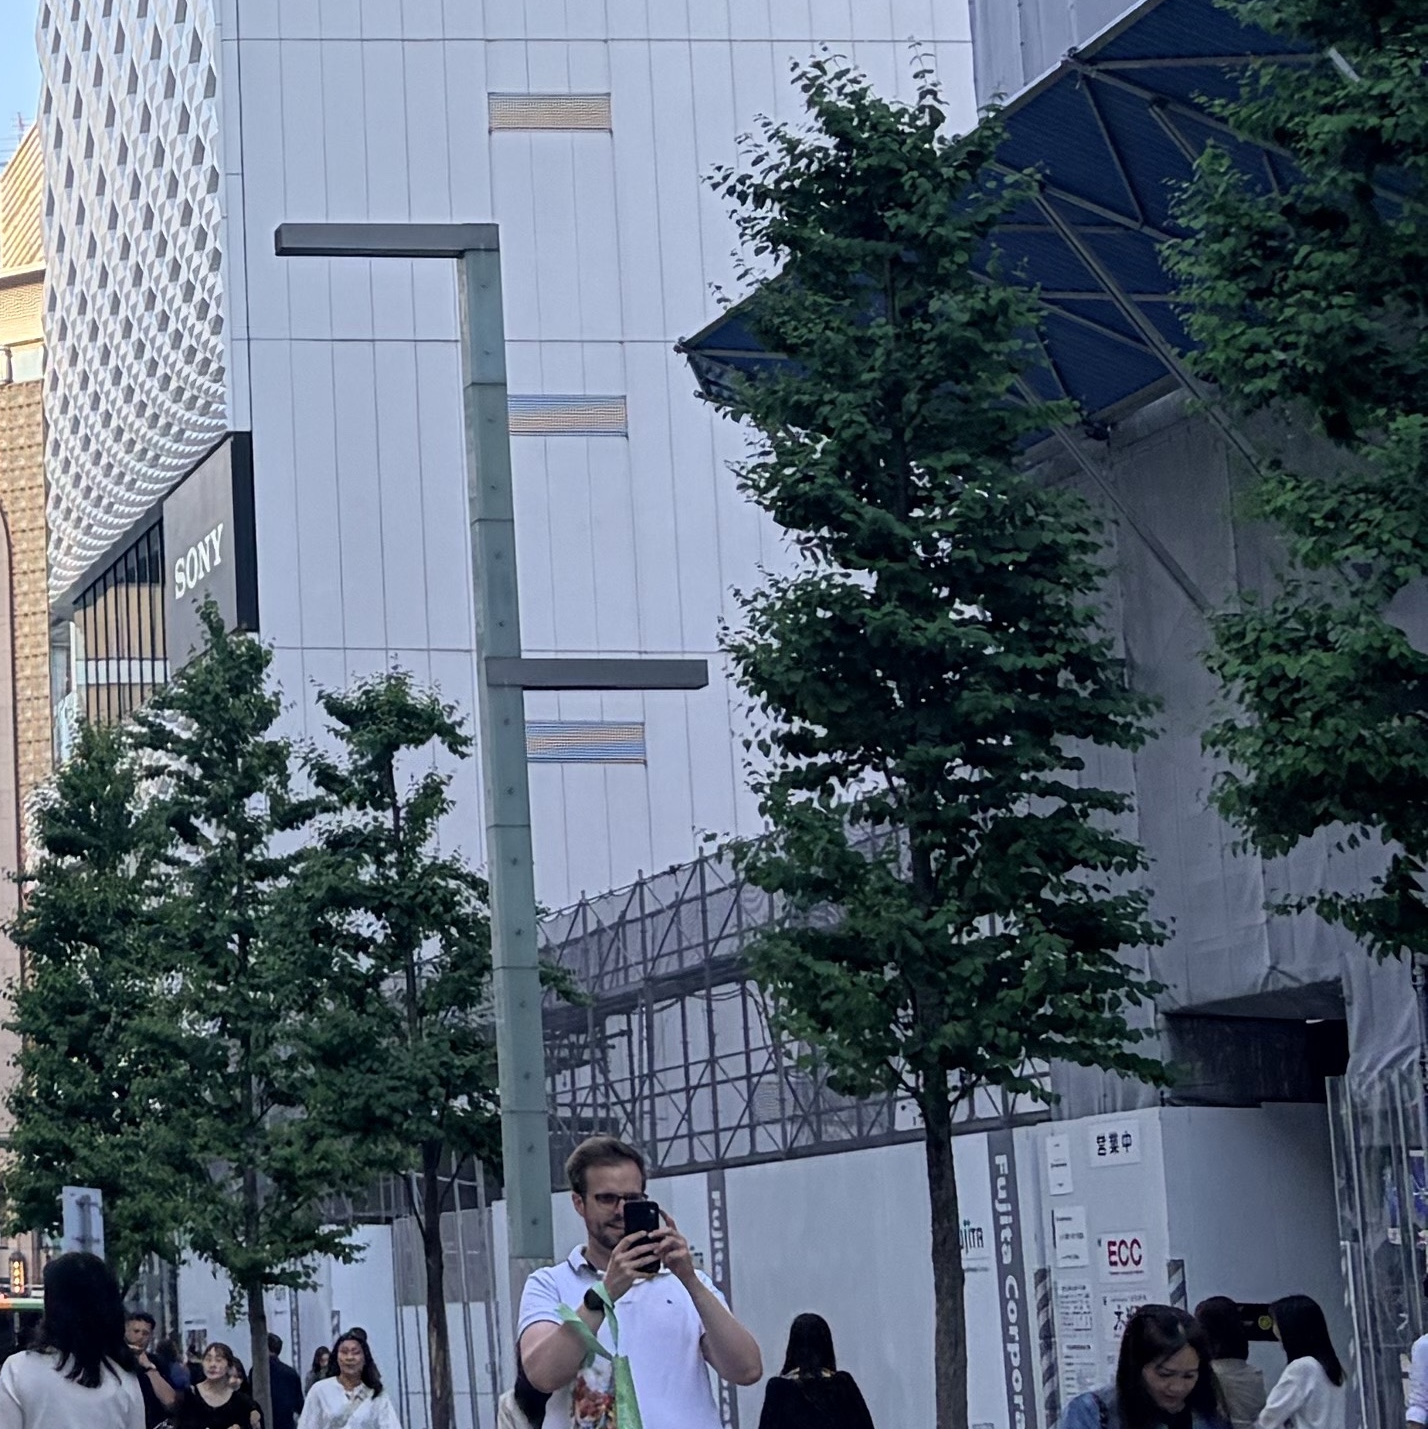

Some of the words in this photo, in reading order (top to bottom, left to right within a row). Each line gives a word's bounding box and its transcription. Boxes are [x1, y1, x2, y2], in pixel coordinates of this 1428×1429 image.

[174, 523, 224, 600] SONY
[994, 1154, 1013, 1265] Fujita
[1107, 1238, 1143, 1267] ECC
